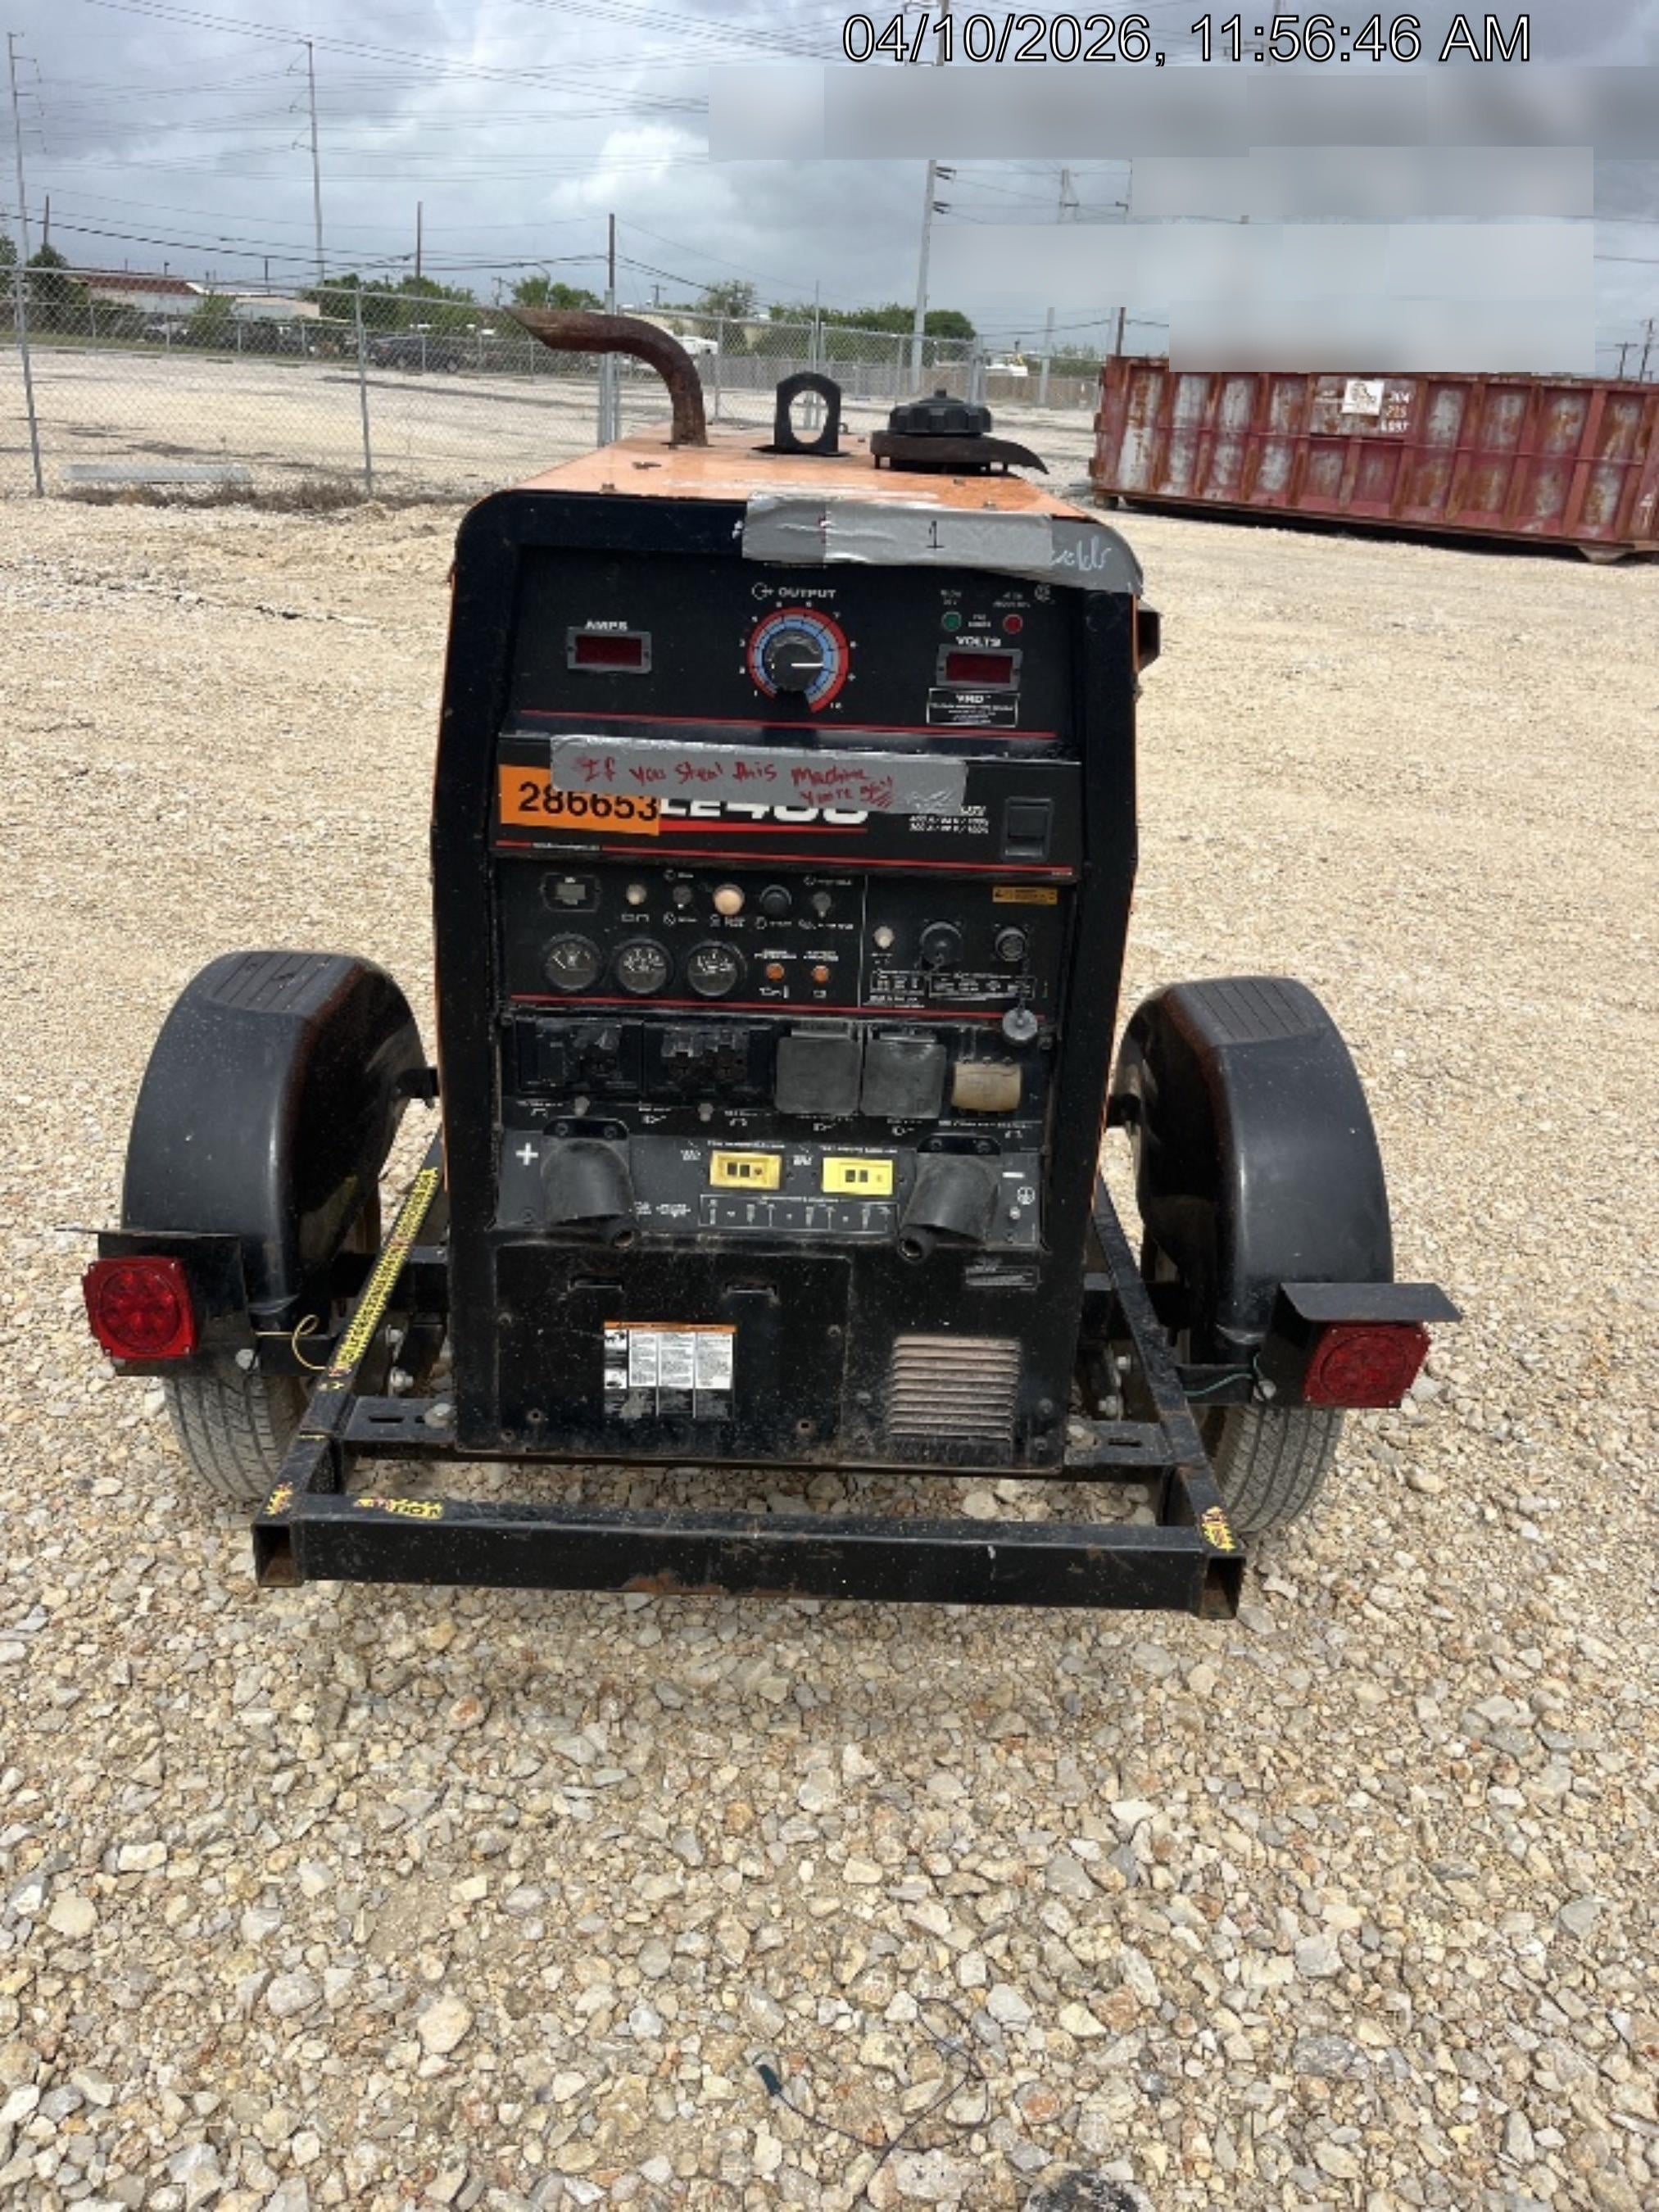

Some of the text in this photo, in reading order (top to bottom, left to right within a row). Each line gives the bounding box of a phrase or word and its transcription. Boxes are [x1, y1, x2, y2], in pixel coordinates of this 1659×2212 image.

[778, 587, 836, 599] OUTPUT
[584, 619, 628, 632] AMPS
[956, 636, 1001, 648] VOLTS
[519, 781, 660, 822] 286653
